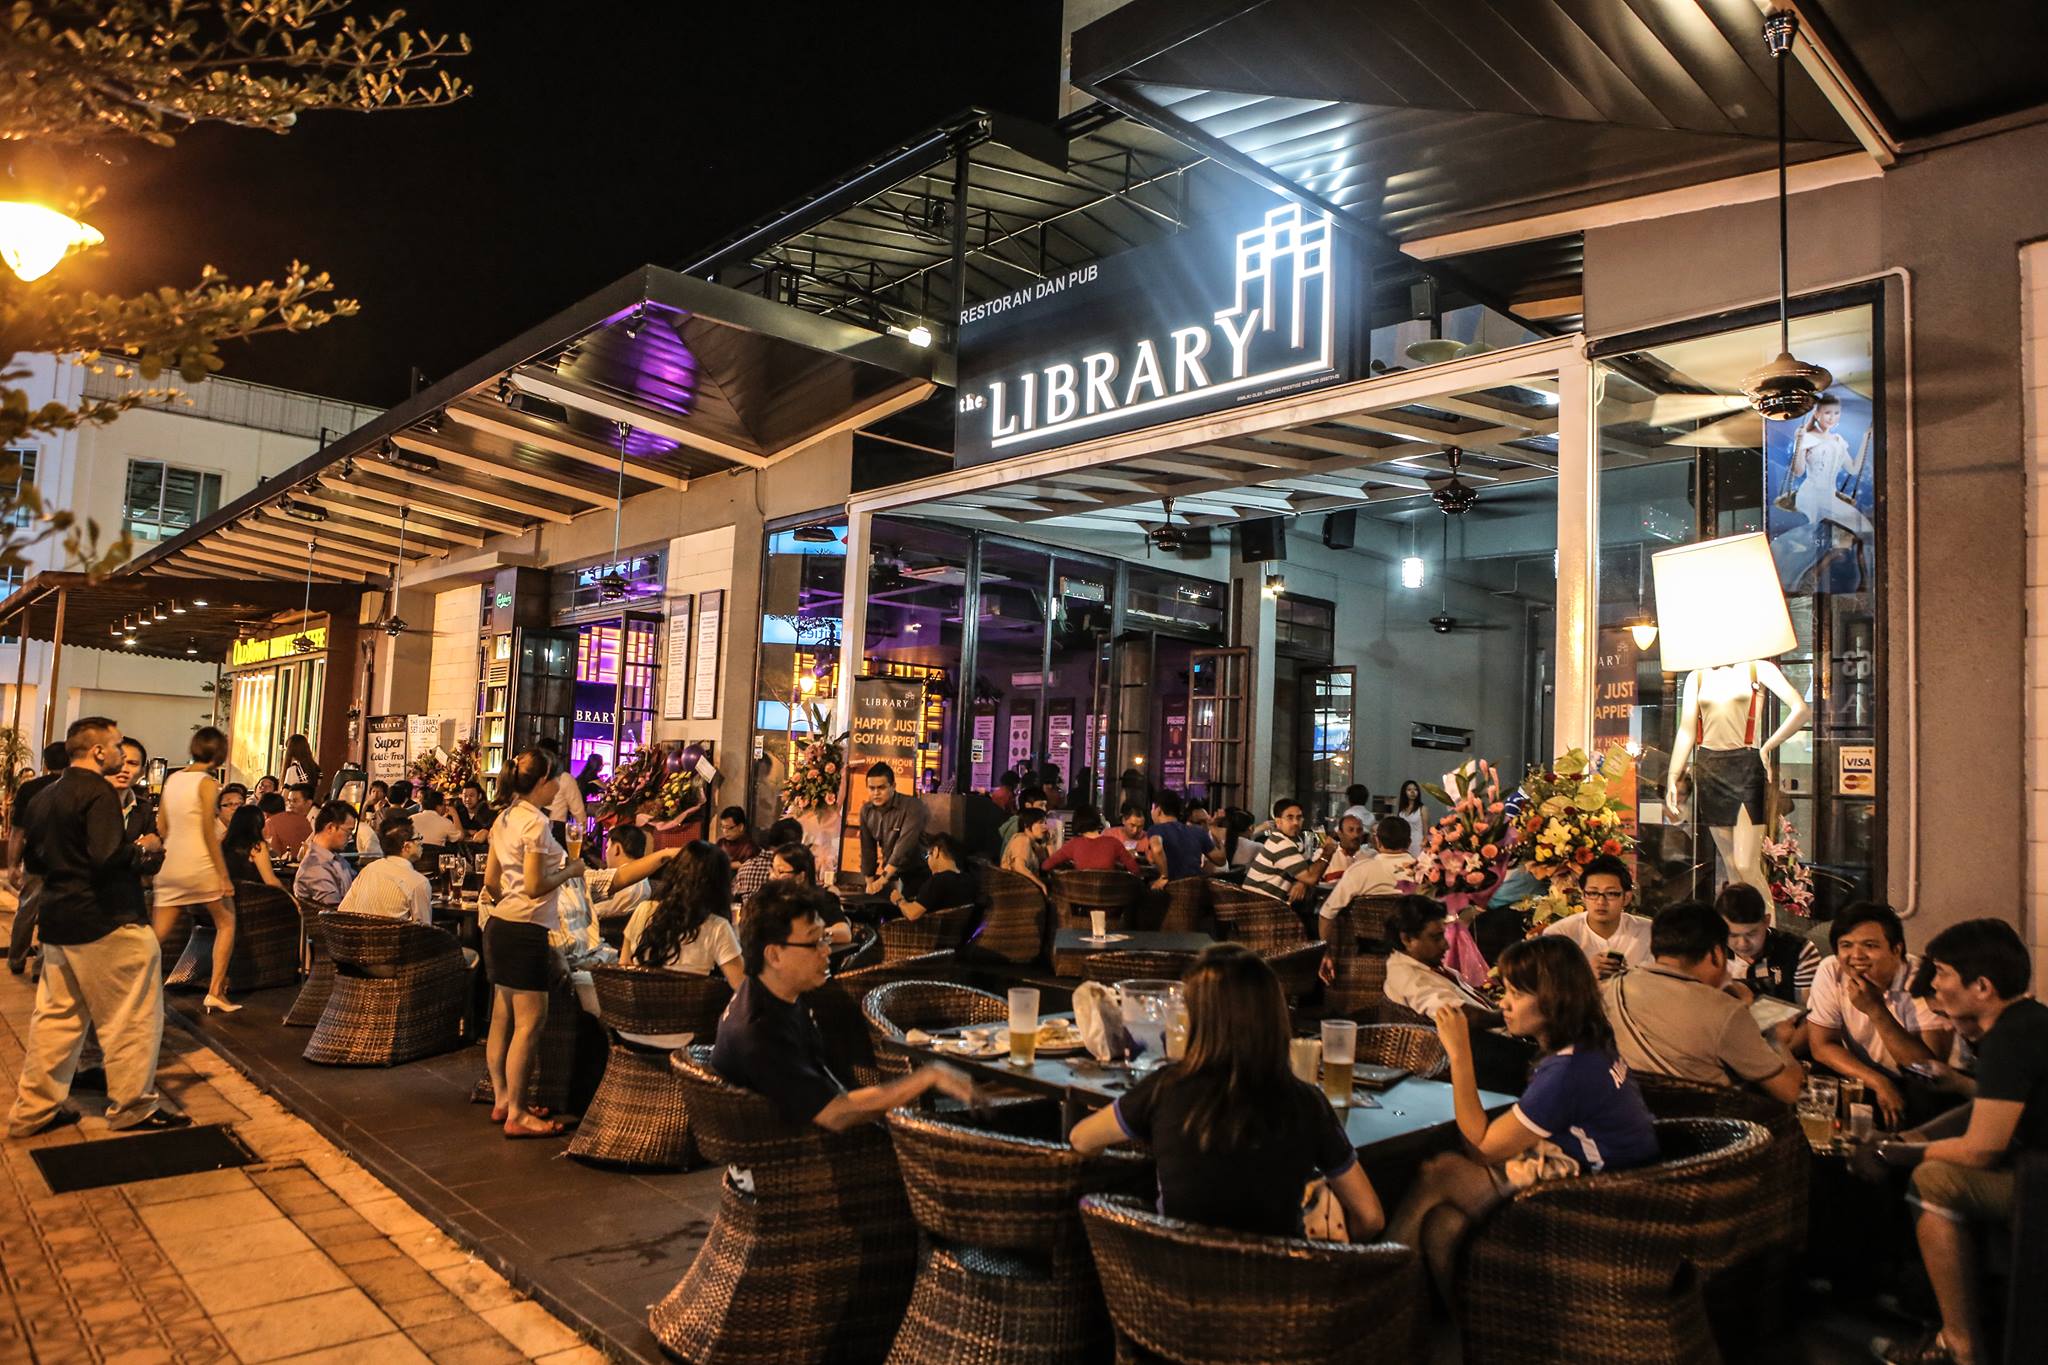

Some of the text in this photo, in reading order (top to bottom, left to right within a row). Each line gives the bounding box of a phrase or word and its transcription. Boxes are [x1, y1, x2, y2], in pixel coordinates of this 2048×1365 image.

[960, 264, 1098, 326] RESTORAN DAN PUB
[959, 309, 1260, 437] the LIBRARY
[1604, 681, 1635, 699] JUST
[865, 697, 909, 708] LIBRARY
[576, 709, 616, 723] BRARY
[1595, 704, 1634, 720] APPIER
[854, 717, 917, 732] HAPPY JUST
[374, 736, 404, 751] Super
[853, 732, 915, 747] GOT HAPPIER
[389, 752, 405, 761] Fres
[1846, 757, 1872, 767] VISA
